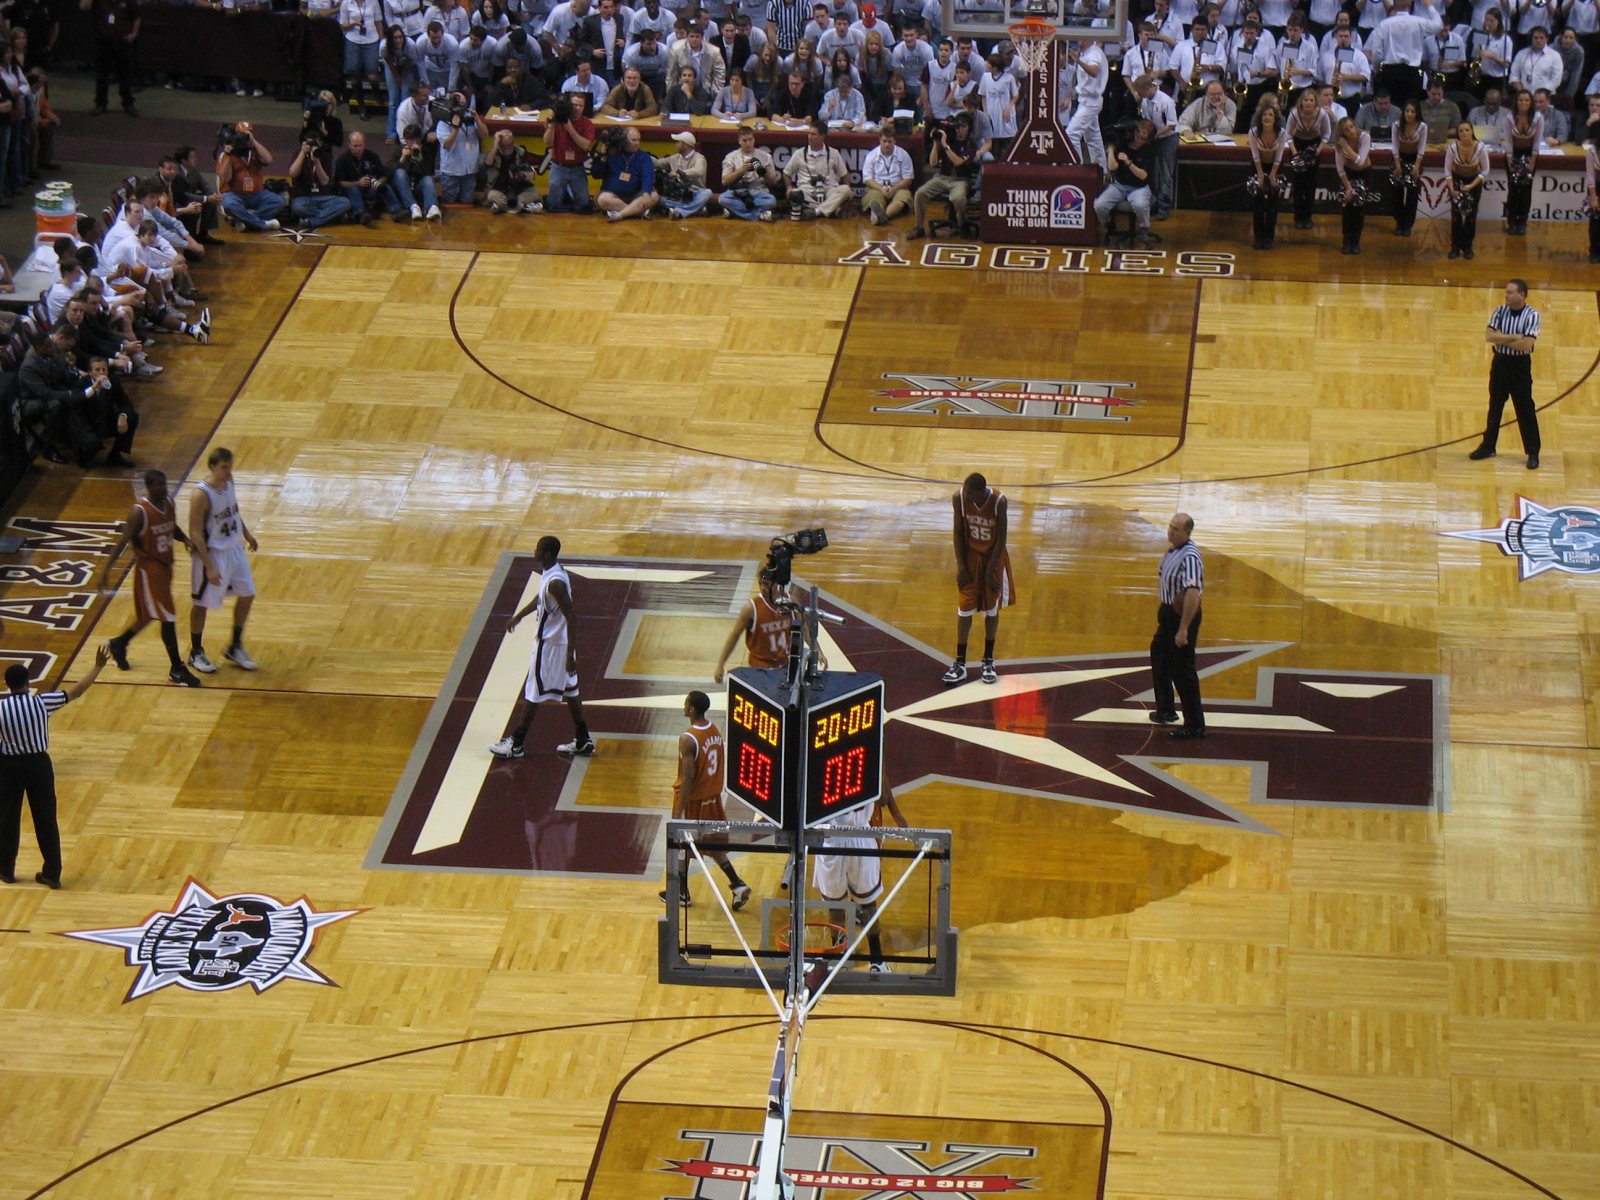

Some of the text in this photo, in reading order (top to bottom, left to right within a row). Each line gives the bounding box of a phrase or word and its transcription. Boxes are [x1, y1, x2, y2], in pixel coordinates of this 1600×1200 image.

[1540, 176, 1586, 193] Dod
[1006, 190, 1049, 203] THINK
[987, 203, 1049, 217] OUTSIDE
[1007, 217, 1048, 227] THE BUN
[837, 241, 1237, 276] AGGIES
[976, 392, 1103, 402] CONFERENCE
[220, 519, 238, 537] 44
[969, 524, 992, 541] 35
[769, 631, 787, 652] 14
[733, 694, 779, 747] 20:00
[814, 699, 875, 749] 20:00
[706, 749, 719, 777] 3
[738, 742, 773, 801] 00
[822, 746, 866, 805] 00
[140, 937, 157, 959] STATE
[154, 907, 222, 974] LONE STAR
[219, 935, 241, 948] VS
[239, 908, 304, 978] SHOWDOWN
[896, 1178, 927, 1188] 12
[935, 1180, 984, 1189] BIG
